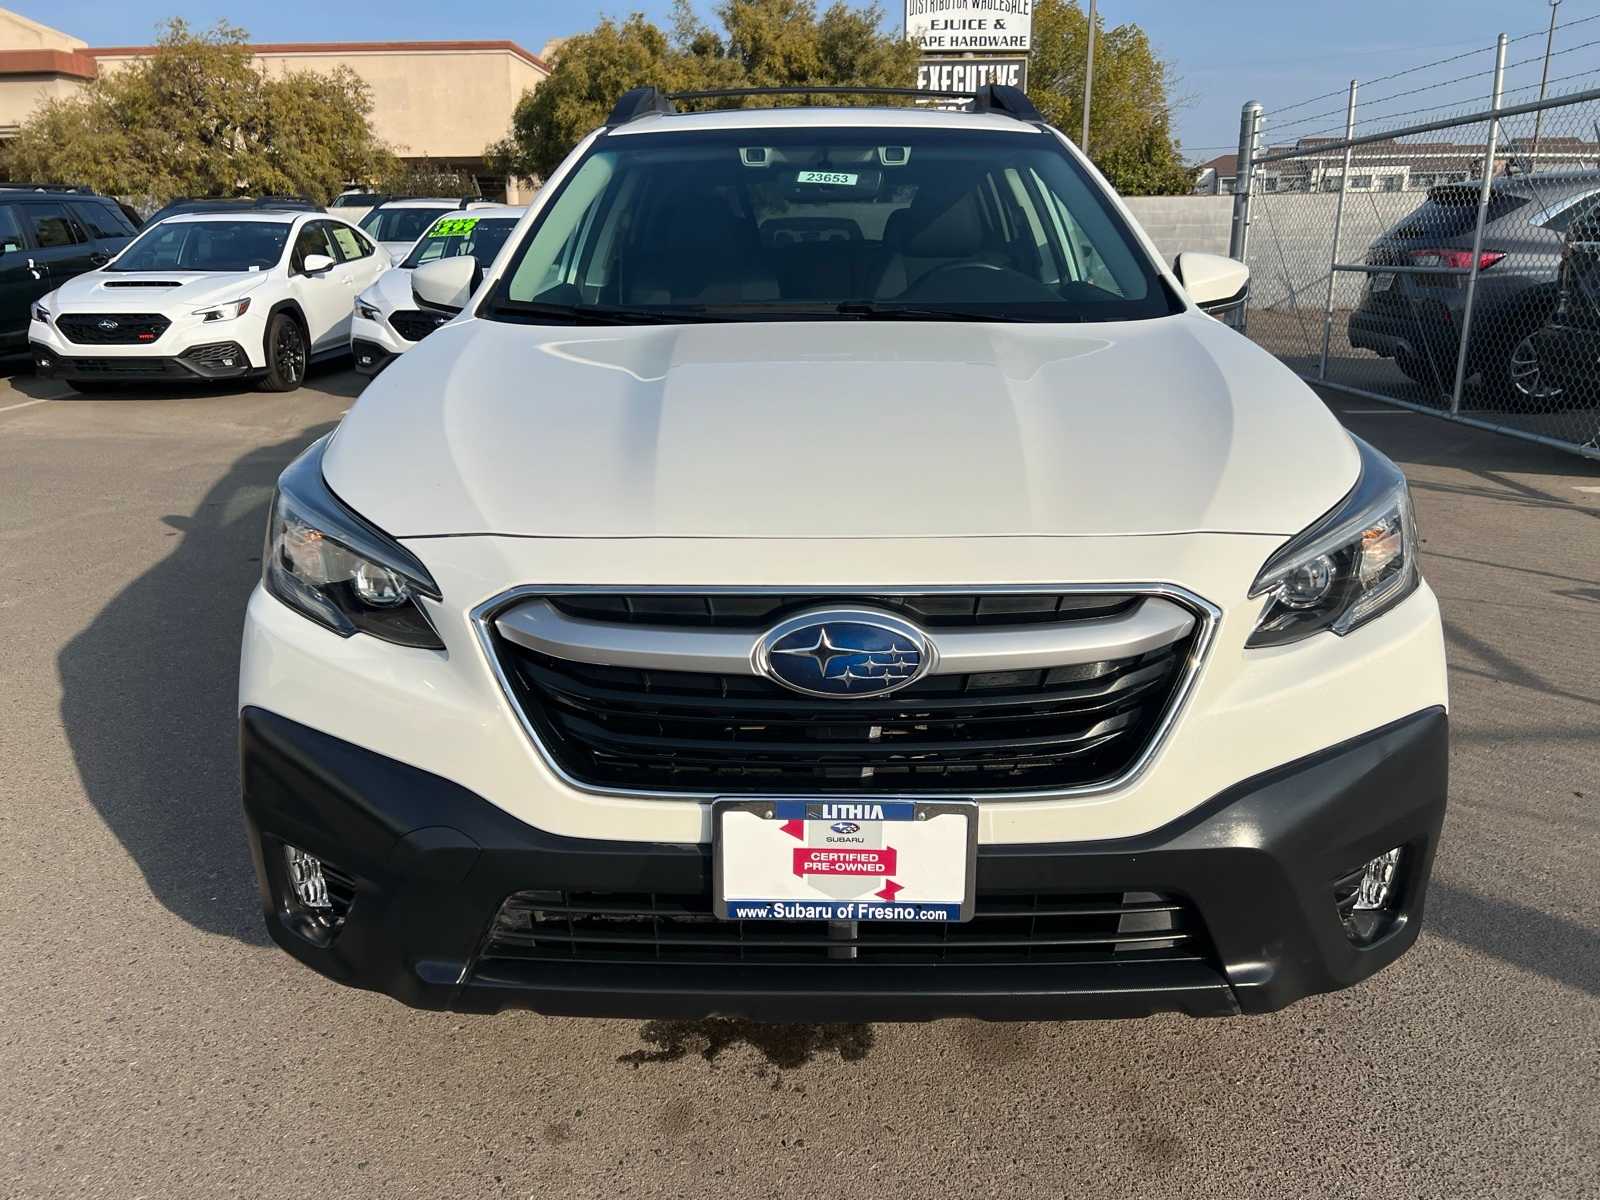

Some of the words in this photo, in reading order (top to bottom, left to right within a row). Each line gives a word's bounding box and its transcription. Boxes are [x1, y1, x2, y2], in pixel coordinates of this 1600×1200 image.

[930, 19, 987, 30] EJUICE
[993, 19, 1007, 30] &
[912, 36, 945, 47] APE
[949, 36, 1027, 47] HARDWARE
[917, 64, 1020, 93] EXECUTIVE
[806, 172, 849, 183] 23653
[822, 804, 884, 819] LITHIA
[825, 836, 865, 844] SUBARU
[810, 852, 879, 862] CERTIFIED
[803, 862, 885, 872] PRE-OWNED
[837, 904, 854, 919] of
